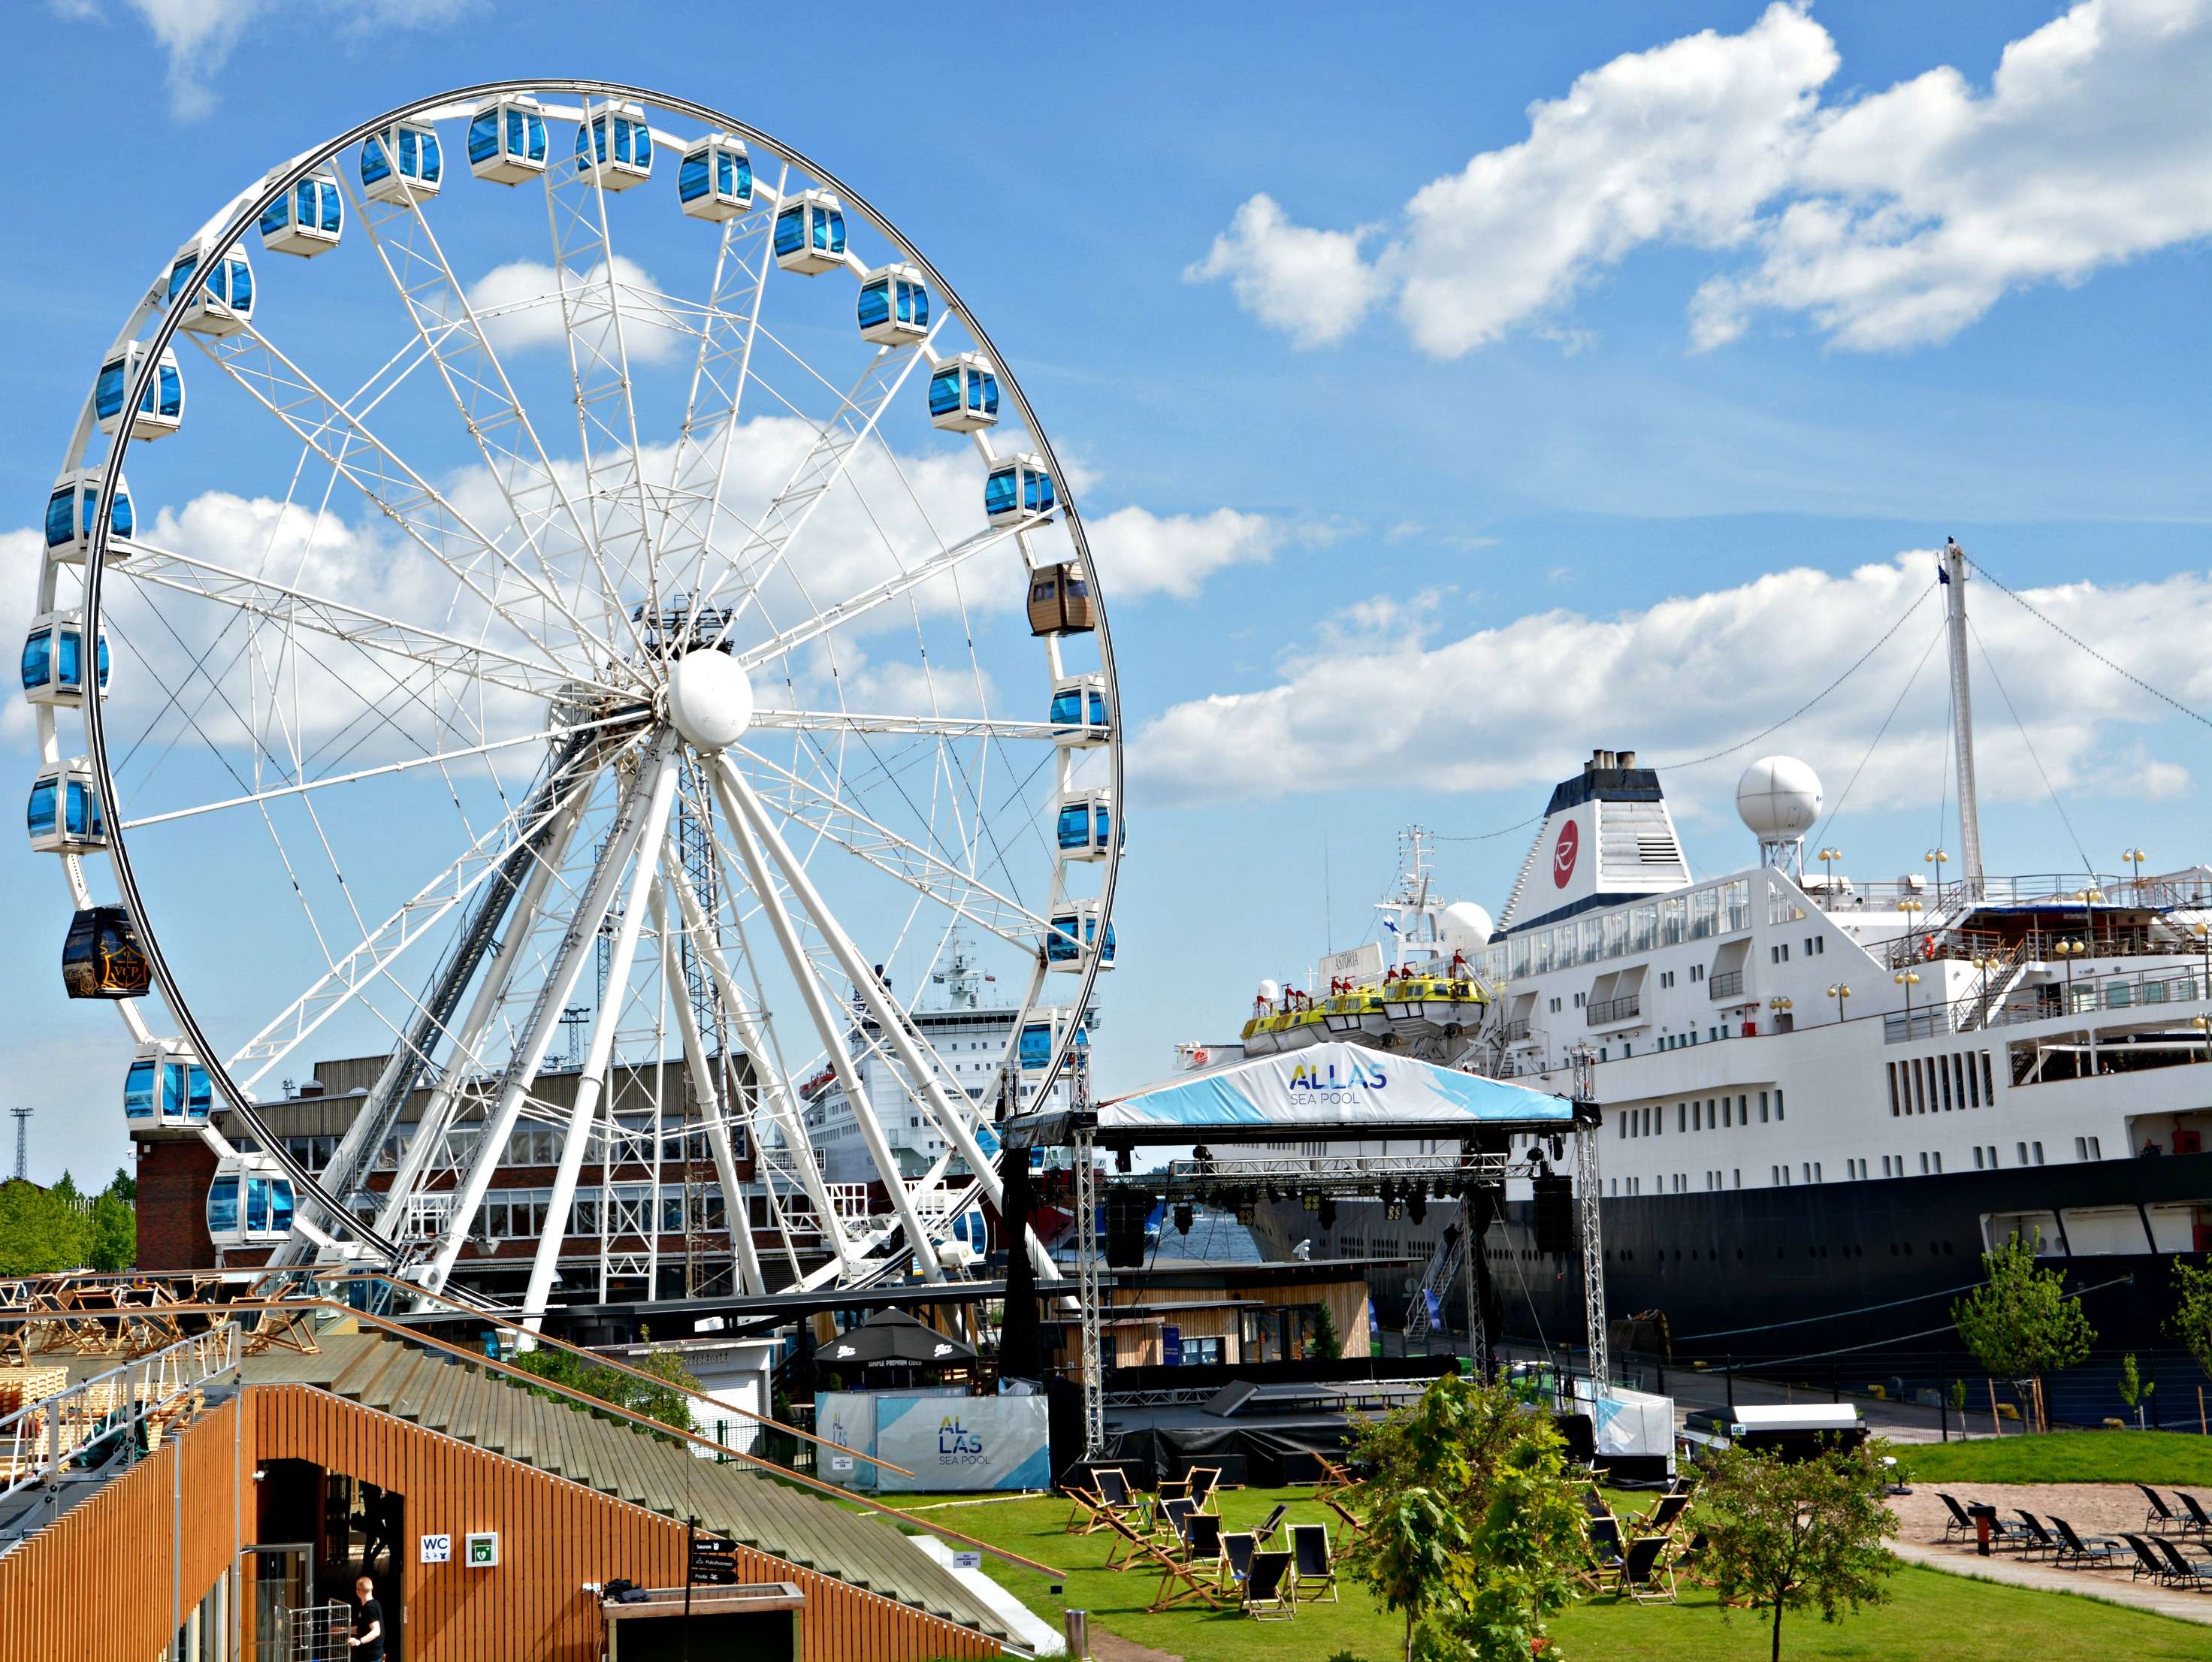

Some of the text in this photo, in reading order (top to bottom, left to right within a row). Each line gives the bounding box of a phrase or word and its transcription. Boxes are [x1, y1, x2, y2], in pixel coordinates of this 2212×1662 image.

[1335, 950, 1358, 970] ASTORIA
[114, 965, 138, 977] VCP
[1289, 1063, 1387, 1089] ALLAS
[1291, 1092, 1361, 1105] SEA POOL
[938, 1416, 968, 1434] AL
[939, 1435, 982, 1454] LAS
[939, 1455, 991, 1465] SEA POOL
[424, 1537, 448, 1549] WC
